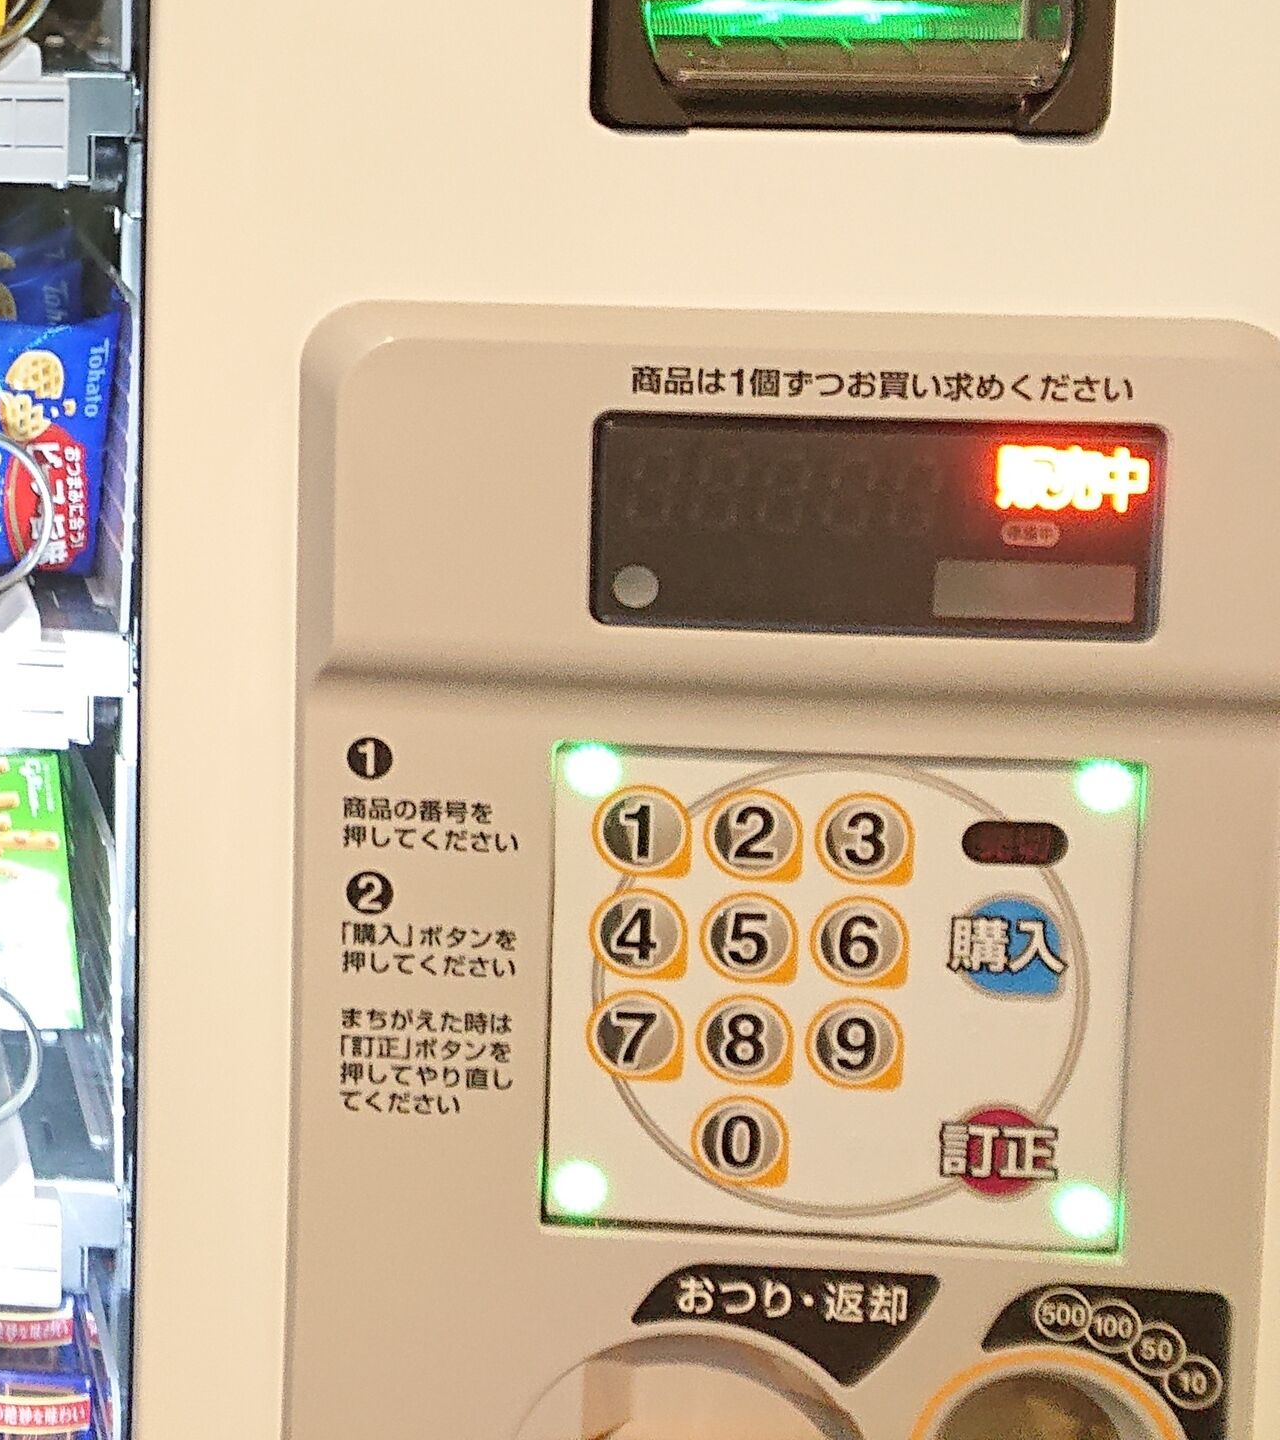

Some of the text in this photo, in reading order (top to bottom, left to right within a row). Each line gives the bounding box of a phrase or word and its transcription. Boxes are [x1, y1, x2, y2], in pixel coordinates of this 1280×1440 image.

[83, 339, 110, 419] Tohato
[630, 365, 1135, 405] 商品は1個ずつお買い求めください
[342, 796, 493, 824] 商品の番号を
[343, 826, 519, 853] 押してください
[623, 804, 887, 866] 1 2 3
[340, 921, 517, 951] 「購入」ボタンを
[615, 907, 880, 970] 4 5 6
[947, 913, 1067, 975] 購入
[341, 950, 516, 978] 押してください
[340, 1008, 512, 1034] まちがえた時は
[616, 1011, 878, 1072] 7 8 9
[340, 1034, 511, 1062] 「訂正」ボタンを
[339, 1063, 513, 1091] 押してやり直し
[339, 1091, 461, 1116] てください
[719, 1112, 761, 1170] 0
[940, 1121, 1059, 1181] 訂正
[675, 1276, 909, 1328] おつり・返却
[1041, 1302, 1208, 1397] 500 100 50 10
